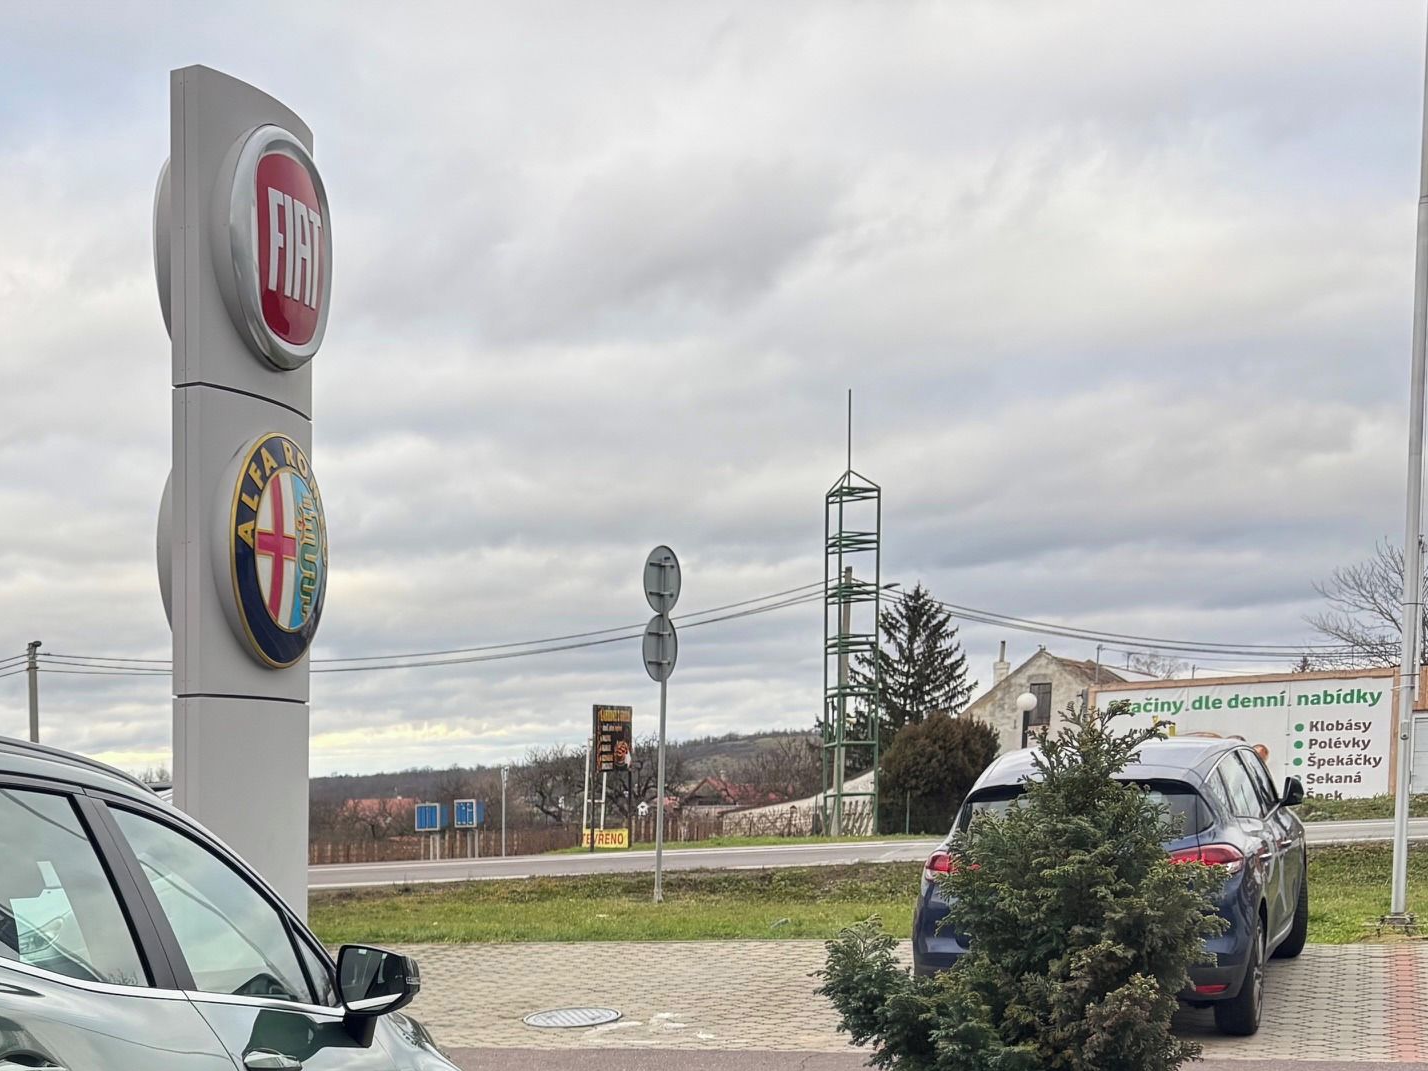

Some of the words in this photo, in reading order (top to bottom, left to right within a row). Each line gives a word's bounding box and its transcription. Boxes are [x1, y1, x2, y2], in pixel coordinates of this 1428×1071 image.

[267, 186, 322, 309] FIAT
[237, 446, 278, 549] ALFA
[1108, 696, 1184, 715] ačiny
[1191, 695, 1222, 711] dle
[1227, 690, 1286, 709] denní
[1296, 688, 1383, 707] nabídky
[1309, 718, 1372, 733] Klobásy
[1308, 737, 1371, 751] Polévky
[1307, 752, 1383, 769] Špekáčky
[1306, 771, 1362, 785] Sekaná
